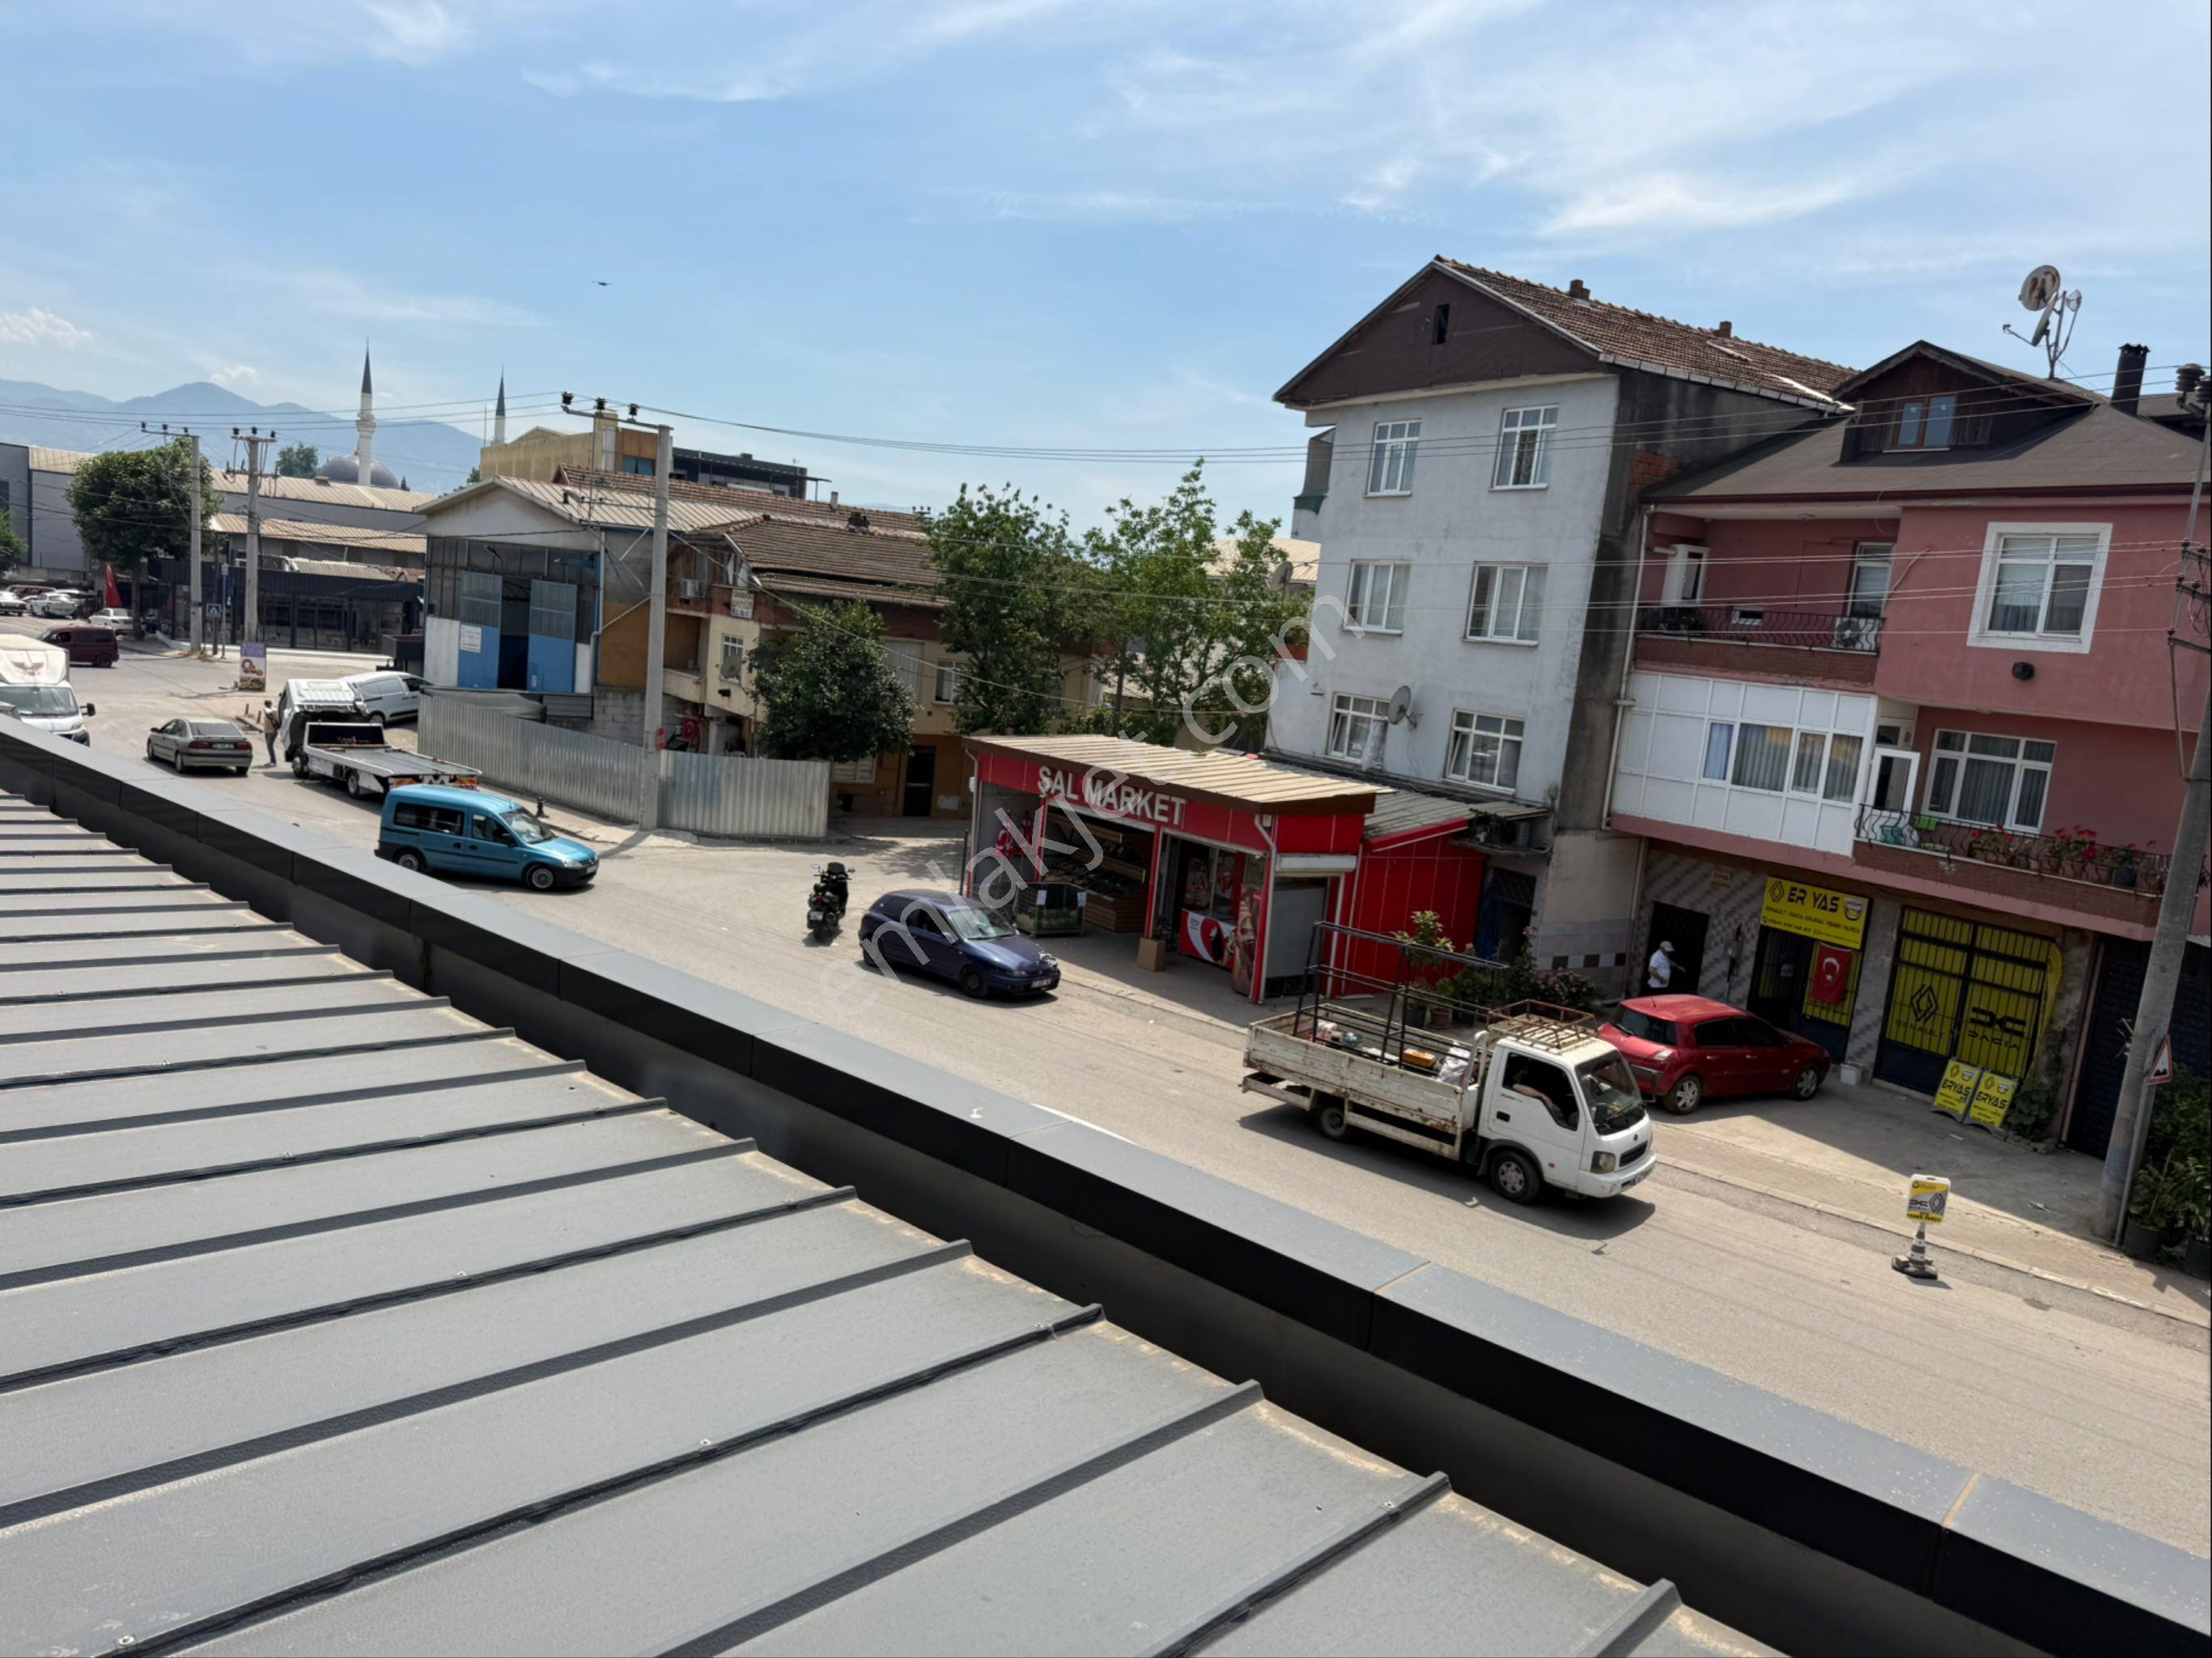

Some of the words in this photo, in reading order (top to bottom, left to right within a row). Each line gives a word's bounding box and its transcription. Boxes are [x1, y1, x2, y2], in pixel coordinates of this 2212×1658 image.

[1037, 765, 1079, 798] ŞAL
[1085, 775, 1187, 825] MARKET
[1787, 886, 1807, 905] ER
[1813, 891, 1841, 913] YAS
[1895, 1019, 1945, 1038] RENAULT
[1968, 1029, 2020, 1050] DACIA
[1941, 1079, 1972, 1096] ERYAS
[1976, 1091, 2007, 1109] ERYAS
